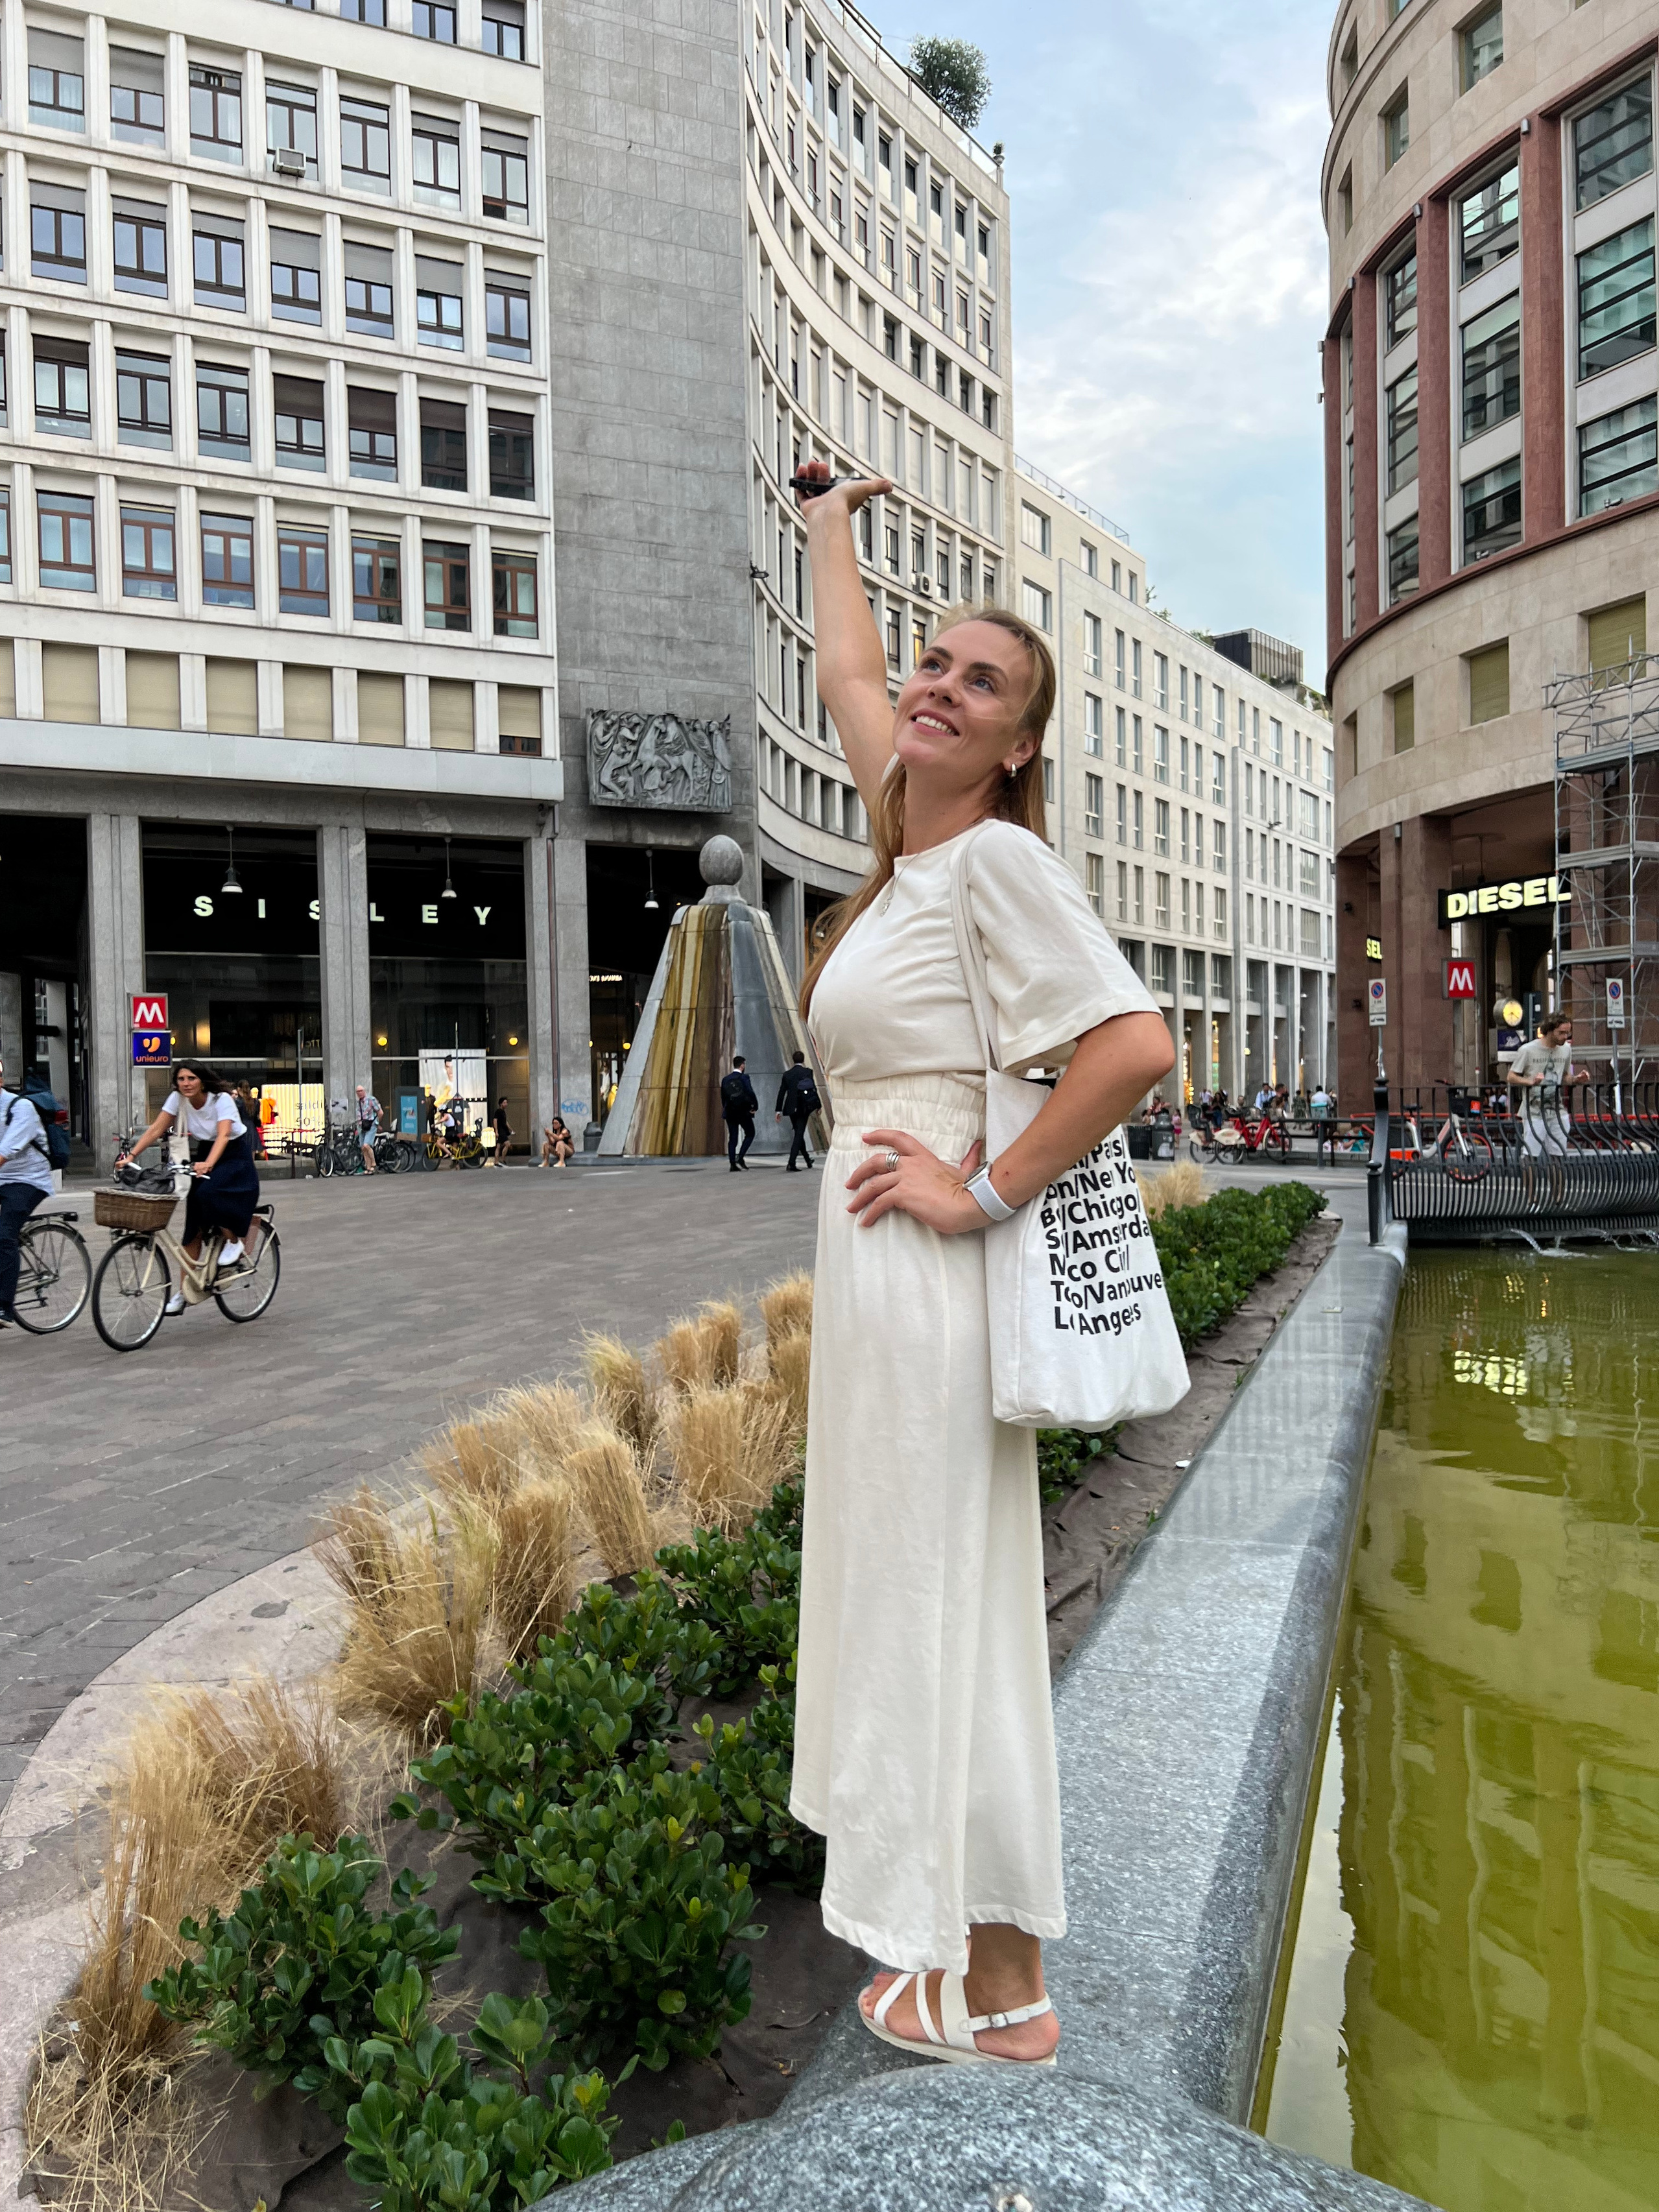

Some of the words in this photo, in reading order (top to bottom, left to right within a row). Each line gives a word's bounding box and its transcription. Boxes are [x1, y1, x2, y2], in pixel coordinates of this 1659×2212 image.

[1448, 876, 1571, 918] DIESEL
[1449, 967, 1474, 991] M
[135, 1002, 164, 1023] M
